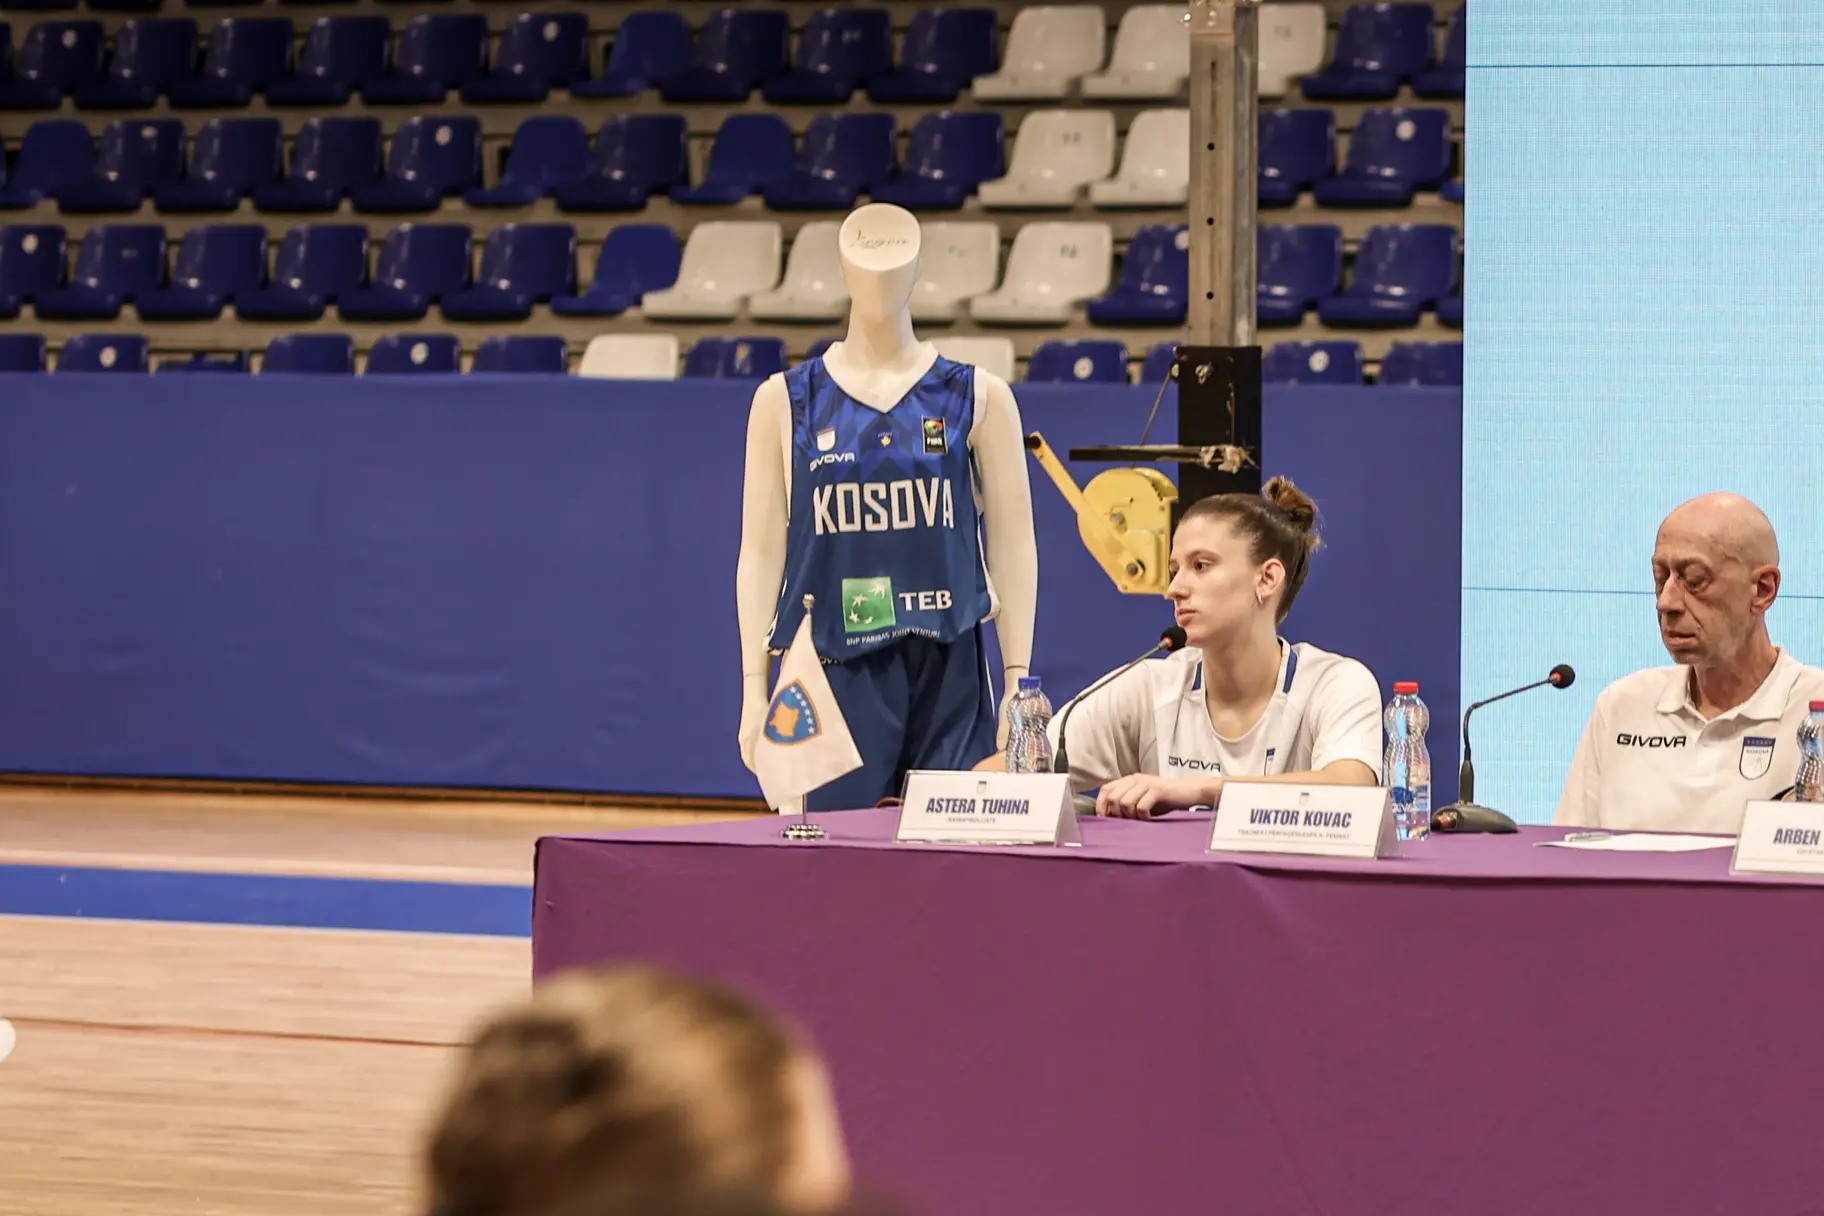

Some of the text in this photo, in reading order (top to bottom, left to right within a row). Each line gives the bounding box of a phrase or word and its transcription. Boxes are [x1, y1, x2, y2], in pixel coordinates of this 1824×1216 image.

[812, 476, 955, 536] KOSOVA
[899, 589, 953, 612] TEB
[1616, 733, 1687, 748] GIVOVA
[926, 797, 1030, 816] ASTERA TUHINA
[1249, 808, 1352, 829] VIKTOR KOVAC
[1773, 828, 1821, 846] ARBEN
